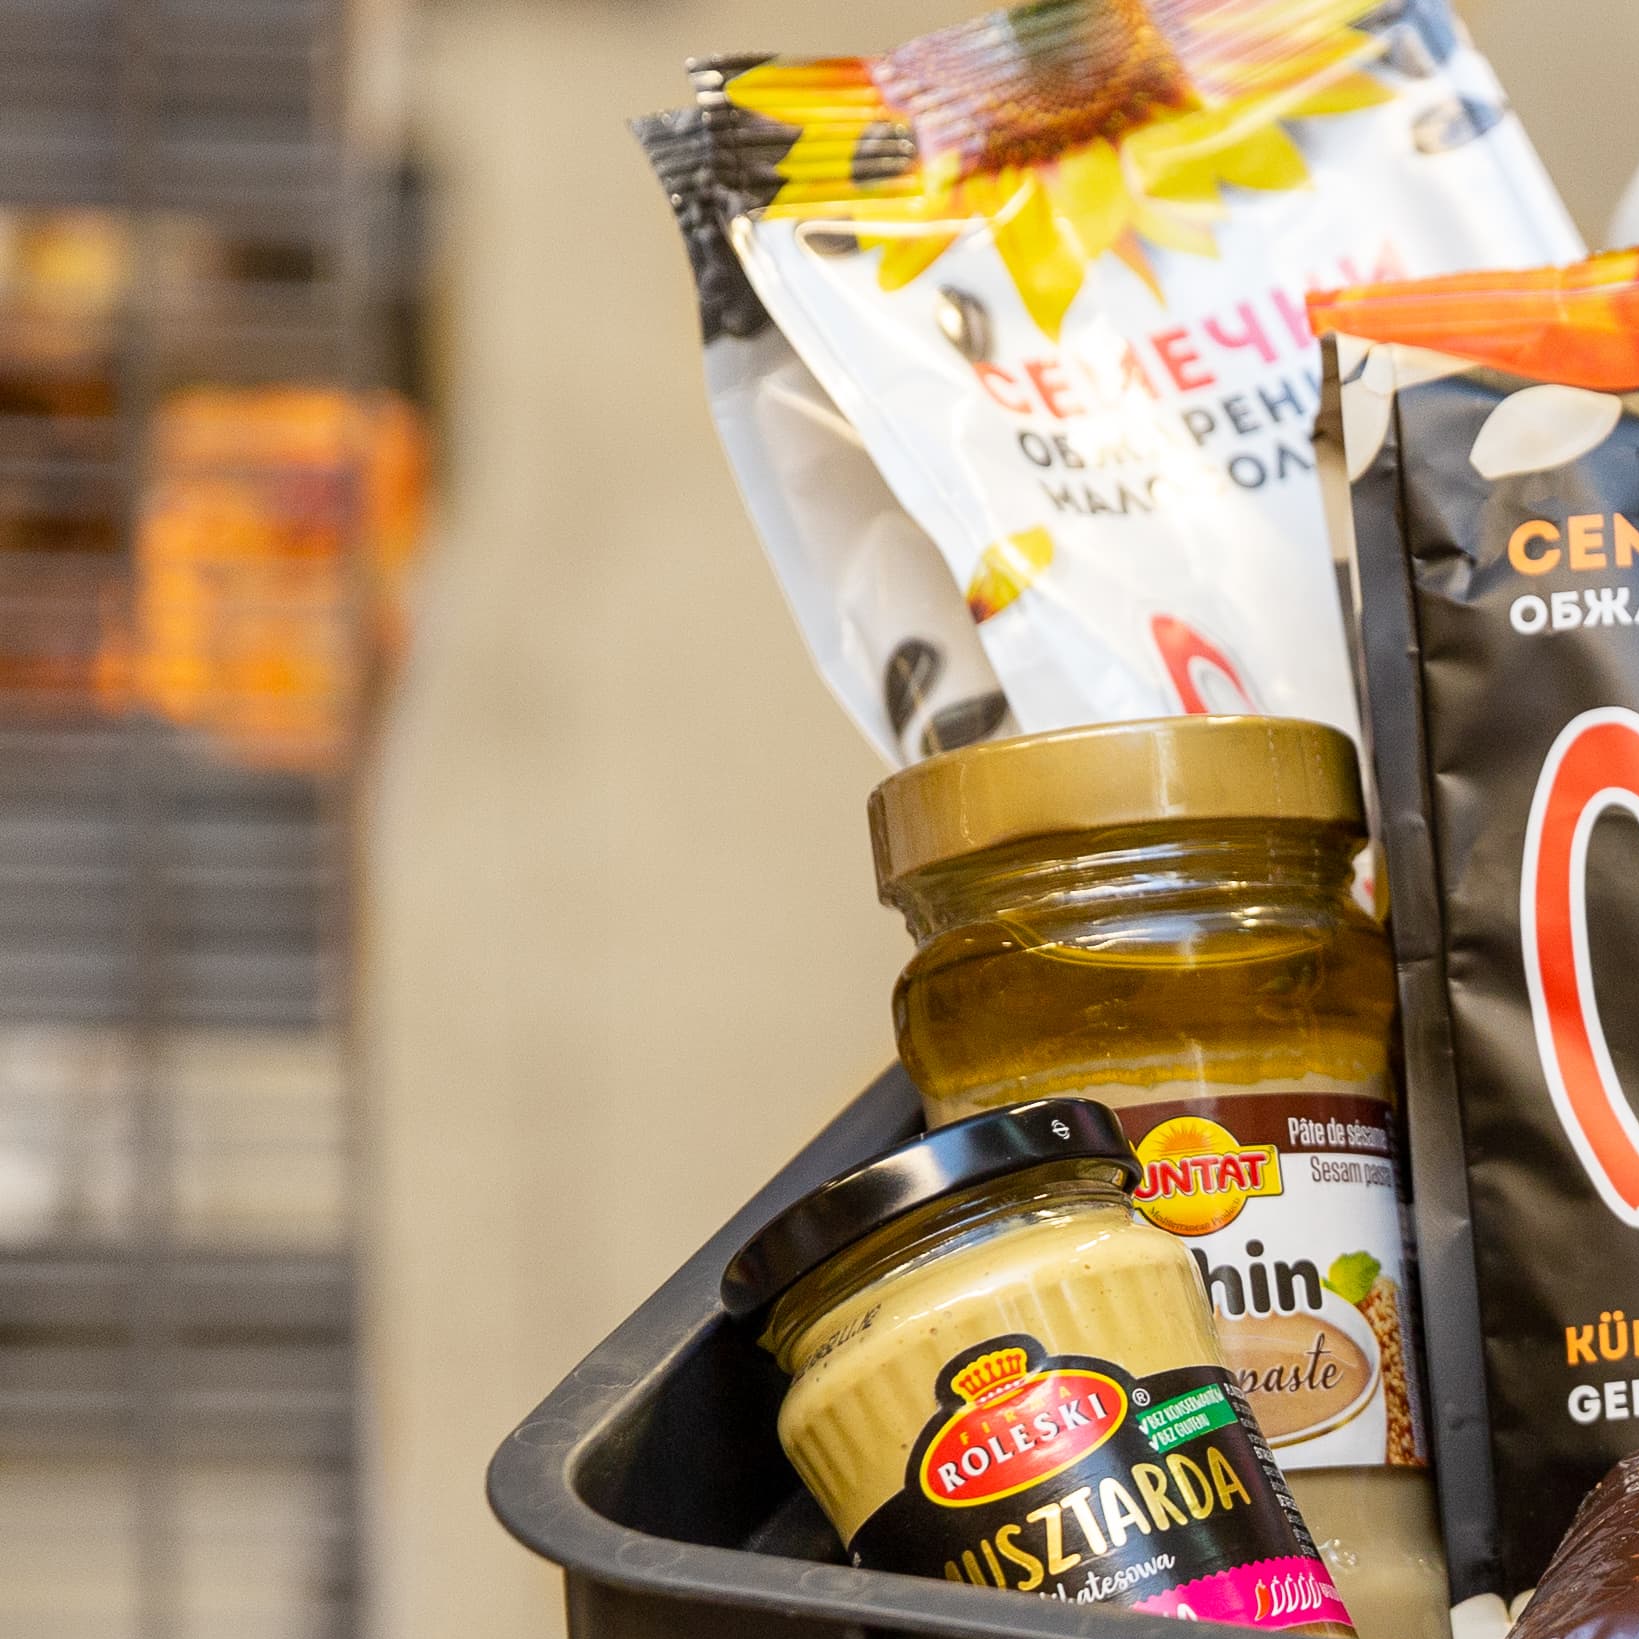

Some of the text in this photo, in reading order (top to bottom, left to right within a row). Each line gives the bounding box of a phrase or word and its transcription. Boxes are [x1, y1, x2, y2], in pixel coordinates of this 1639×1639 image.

[1287, 1117, 1325, 1146] Pâte
[1327, 1117, 1345, 1146] de
[1310, 1155, 1363, 1184] Sesam
[1190, 1238, 1323, 1317] hin
[1238, 1332, 1344, 1393] paste
[937, 1392, 1109, 1494] ROLESKI
[944, 1446, 1252, 1592] USZTARDA
[1040, 1552, 1176, 1606] atesowa
